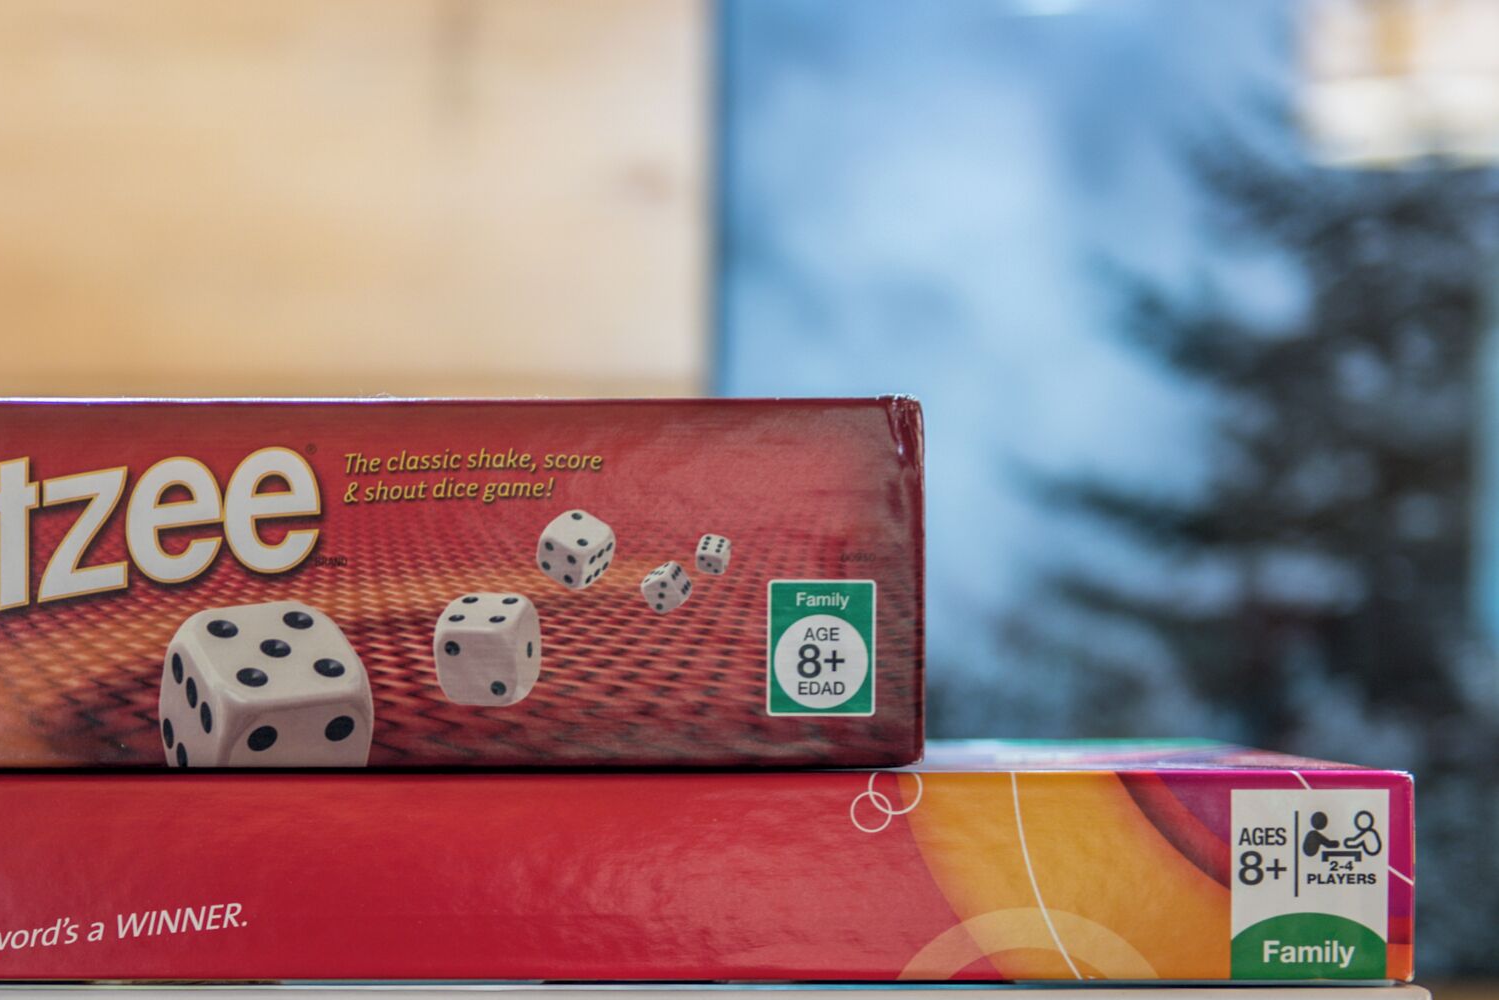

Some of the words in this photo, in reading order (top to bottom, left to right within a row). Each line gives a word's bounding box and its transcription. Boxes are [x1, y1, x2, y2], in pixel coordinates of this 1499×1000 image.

[344, 453, 380, 473] The
[387, 449, 461, 471] classic
[467, 448, 536, 472] shake,
[543, 453, 603, 470] score
[344, 482, 358, 503] &
[364, 481, 426, 502] shout
[432, 478, 478, 499] dice
[483, 477, 554, 503] game!
[795, 592, 850, 610] Family
[804, 627, 840, 641] AGE
[797, 644, 845, 678] 8+
[798, 681, 845, 695] EDAD
[1239, 827, 1287, 846] AGES
[1238, 851, 1288, 886] 8+
[1329, 862, 1353, 872] 2-4
[1307, 874, 1377, 885] PLAYERS
[87, 922, 105, 941] a
[117, 903, 248, 938] WINNER.
[1263, 940, 1356, 968] Family
